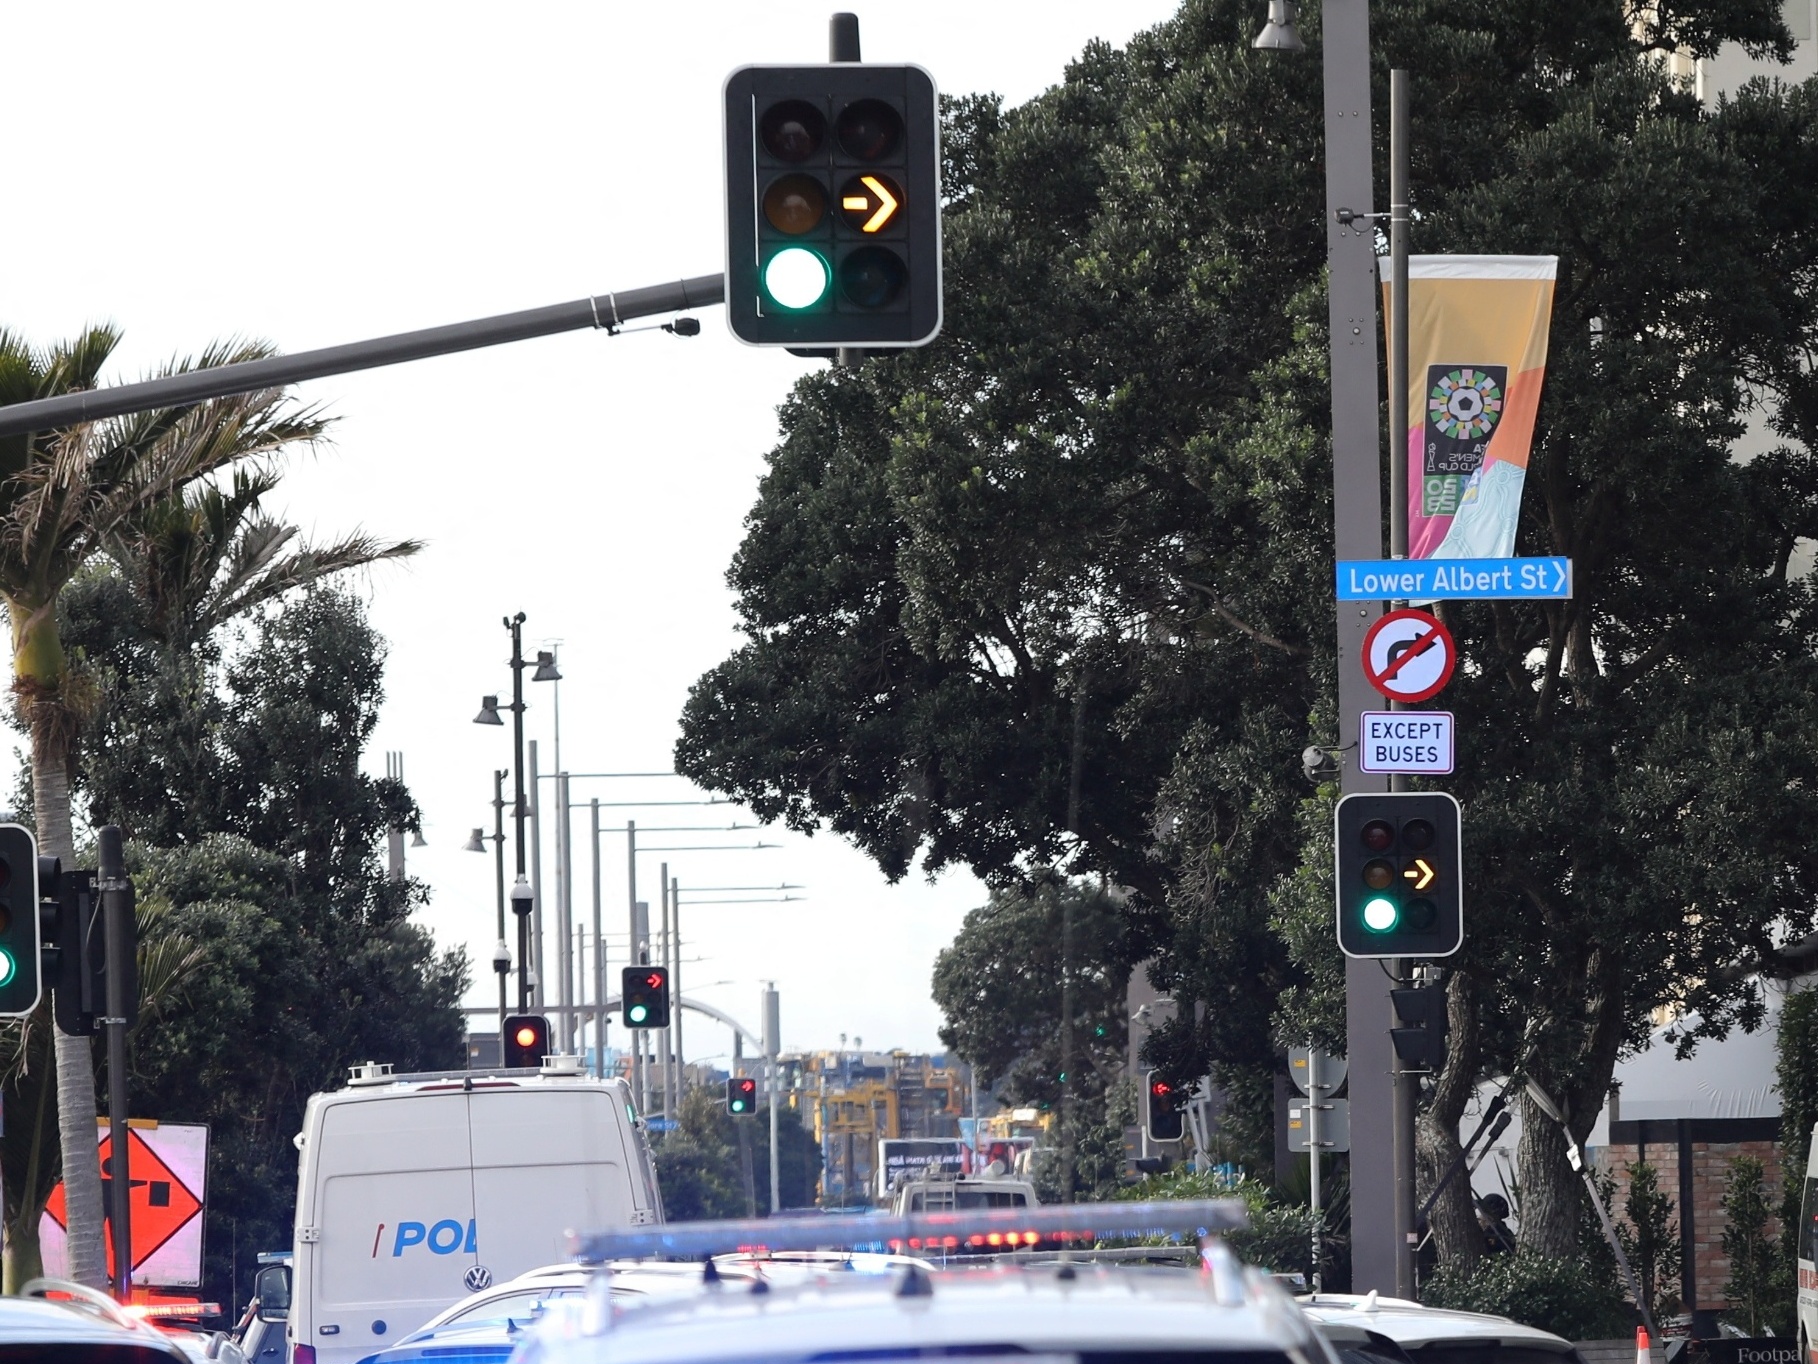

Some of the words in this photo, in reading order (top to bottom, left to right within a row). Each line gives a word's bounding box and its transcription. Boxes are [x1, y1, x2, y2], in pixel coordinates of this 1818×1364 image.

[1351, 568, 1425, 593] Lower
[1432, 566, 1512, 592] Albert
[1520, 564, 1548, 590] St
[1371, 722, 1443, 739] EXCEPT
[1376, 746, 1438, 762] BUSES
